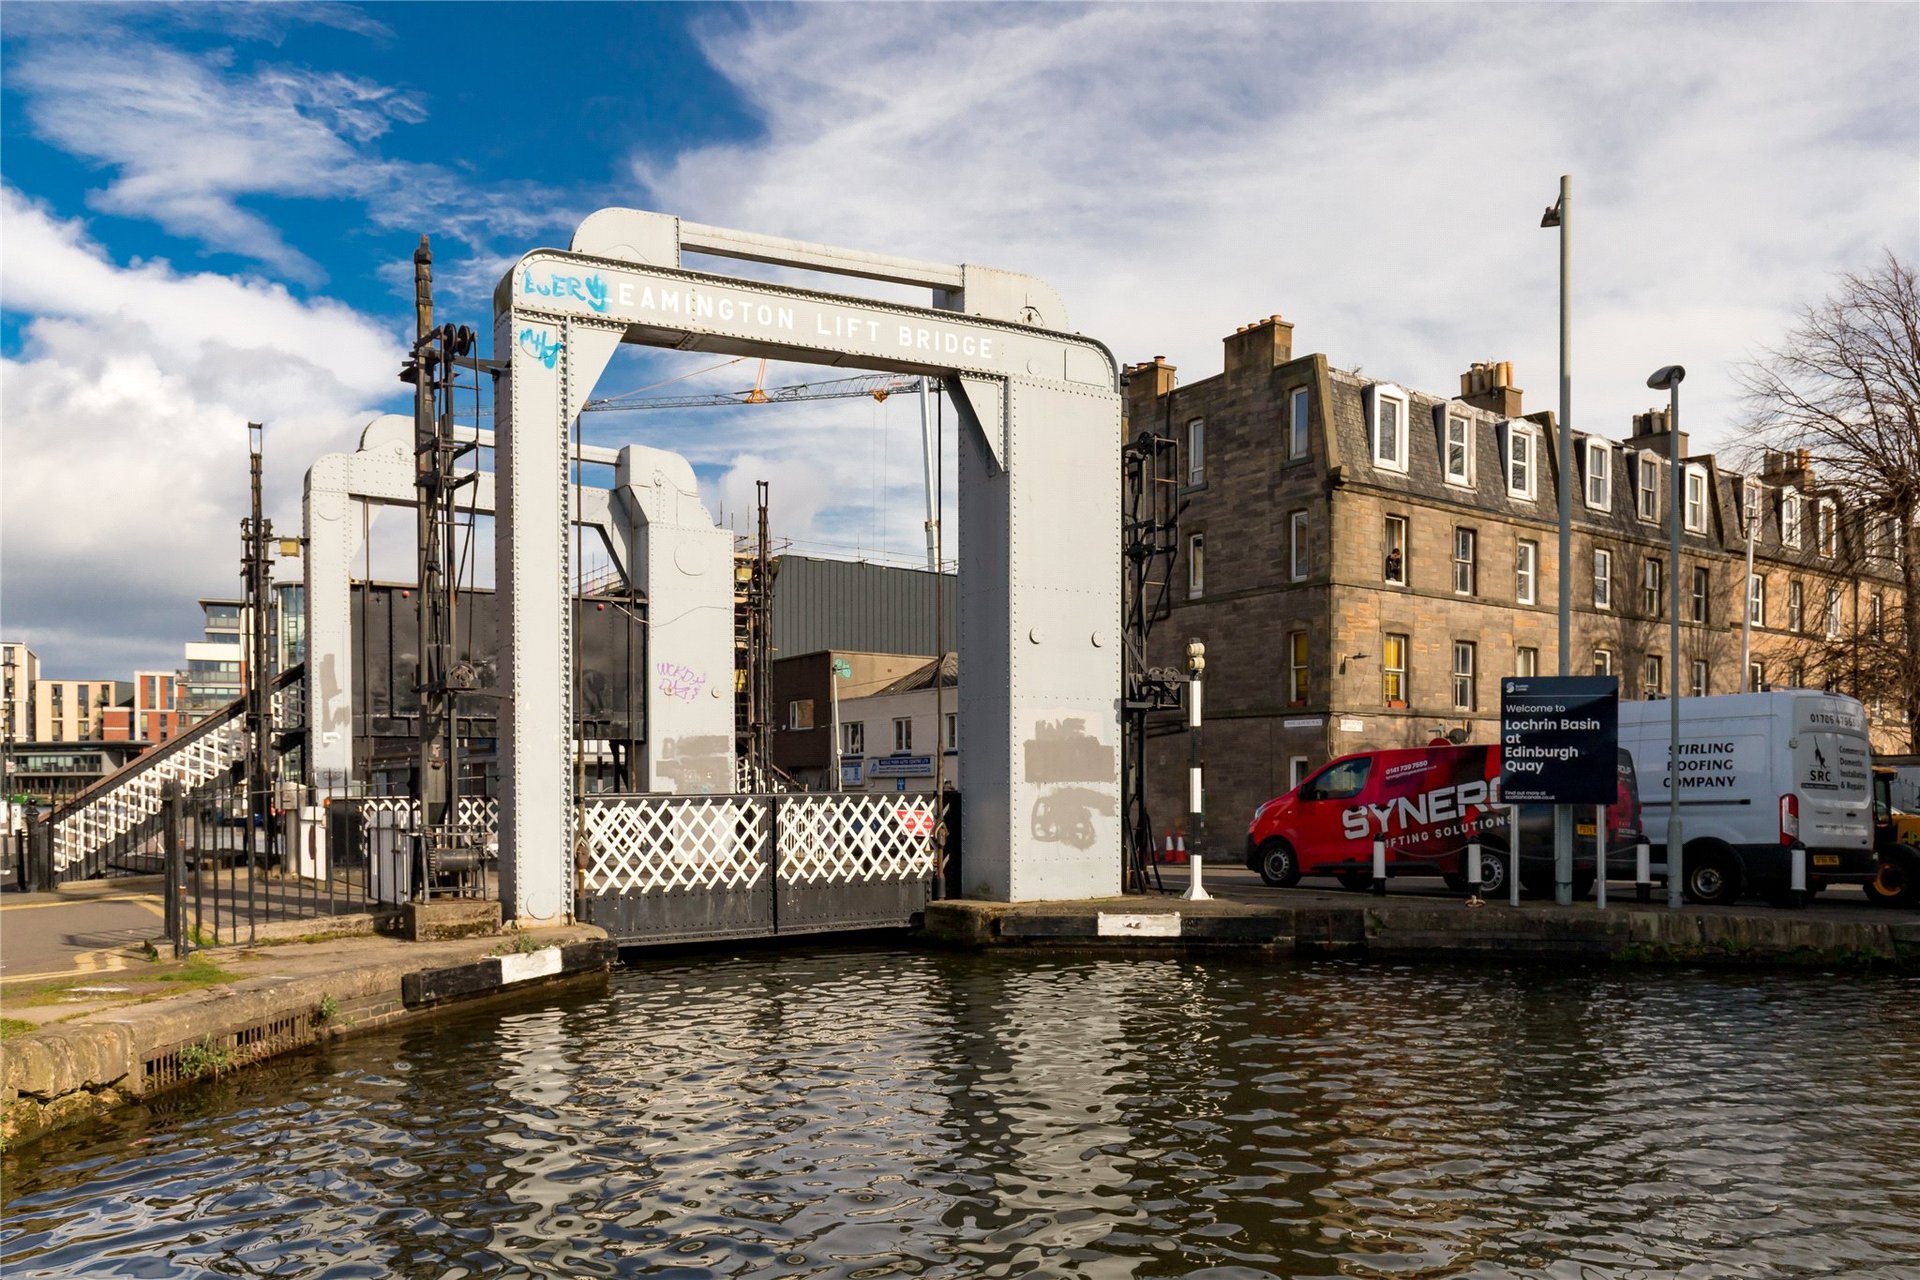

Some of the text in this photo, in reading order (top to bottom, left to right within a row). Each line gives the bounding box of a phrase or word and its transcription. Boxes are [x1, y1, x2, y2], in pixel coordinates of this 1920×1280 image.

[817, 313, 880, 342] LIFT
[898, 325, 992, 358] BRIDGE
[1506, 704, 1566, 712] Welcome to
[1505, 718, 1600, 730] Lochrin Basin
[1505, 733, 1521, 744] at
[1505, 746, 1579, 761] Edinburgh
[1505, 761, 1544, 775] Quay
[1810, 770, 1831, 782] SRC
[1435, 814, 1511, 839] SOLUTIONS
[1385, 831, 1429, 848] IFTING
